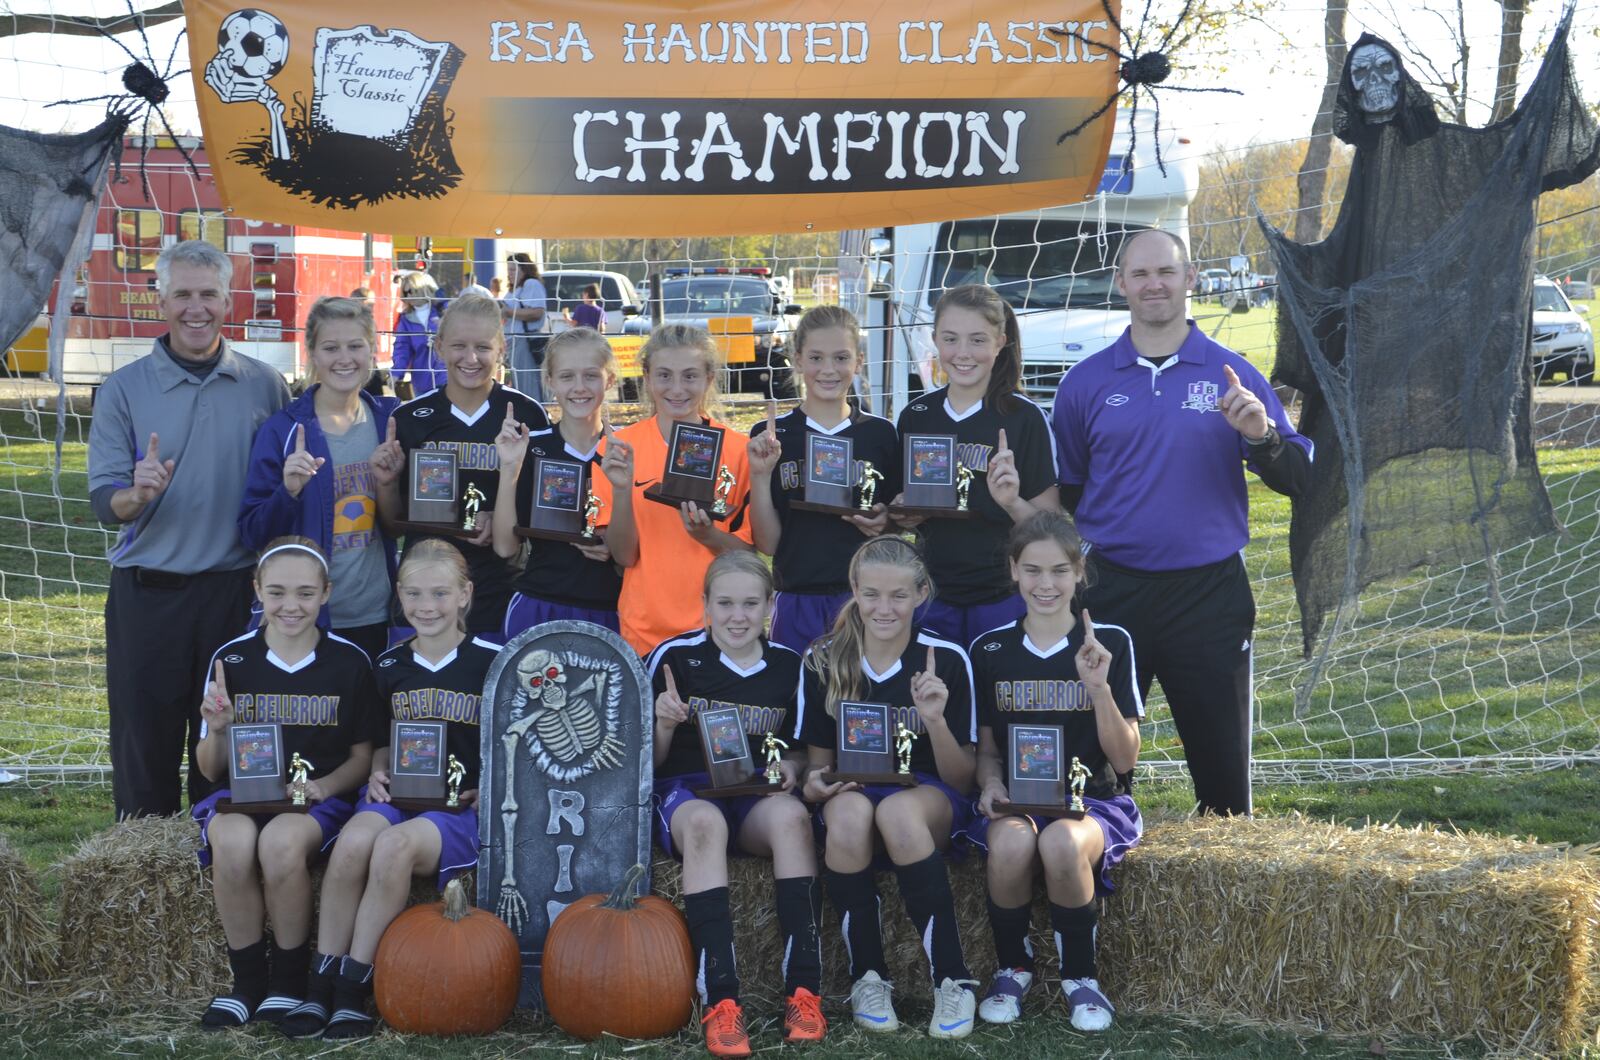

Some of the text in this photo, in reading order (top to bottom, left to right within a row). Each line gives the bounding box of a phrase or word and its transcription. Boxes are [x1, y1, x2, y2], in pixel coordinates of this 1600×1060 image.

[489, 20, 1108, 64] BSA HAUNTED CLASSIC
[333, 52, 420, 81] Haunted
[338, 78, 406, 103] Classic
[572, 110, 1027, 182] CHAMPION
[256, 694, 340, 726] BELLBROOK
